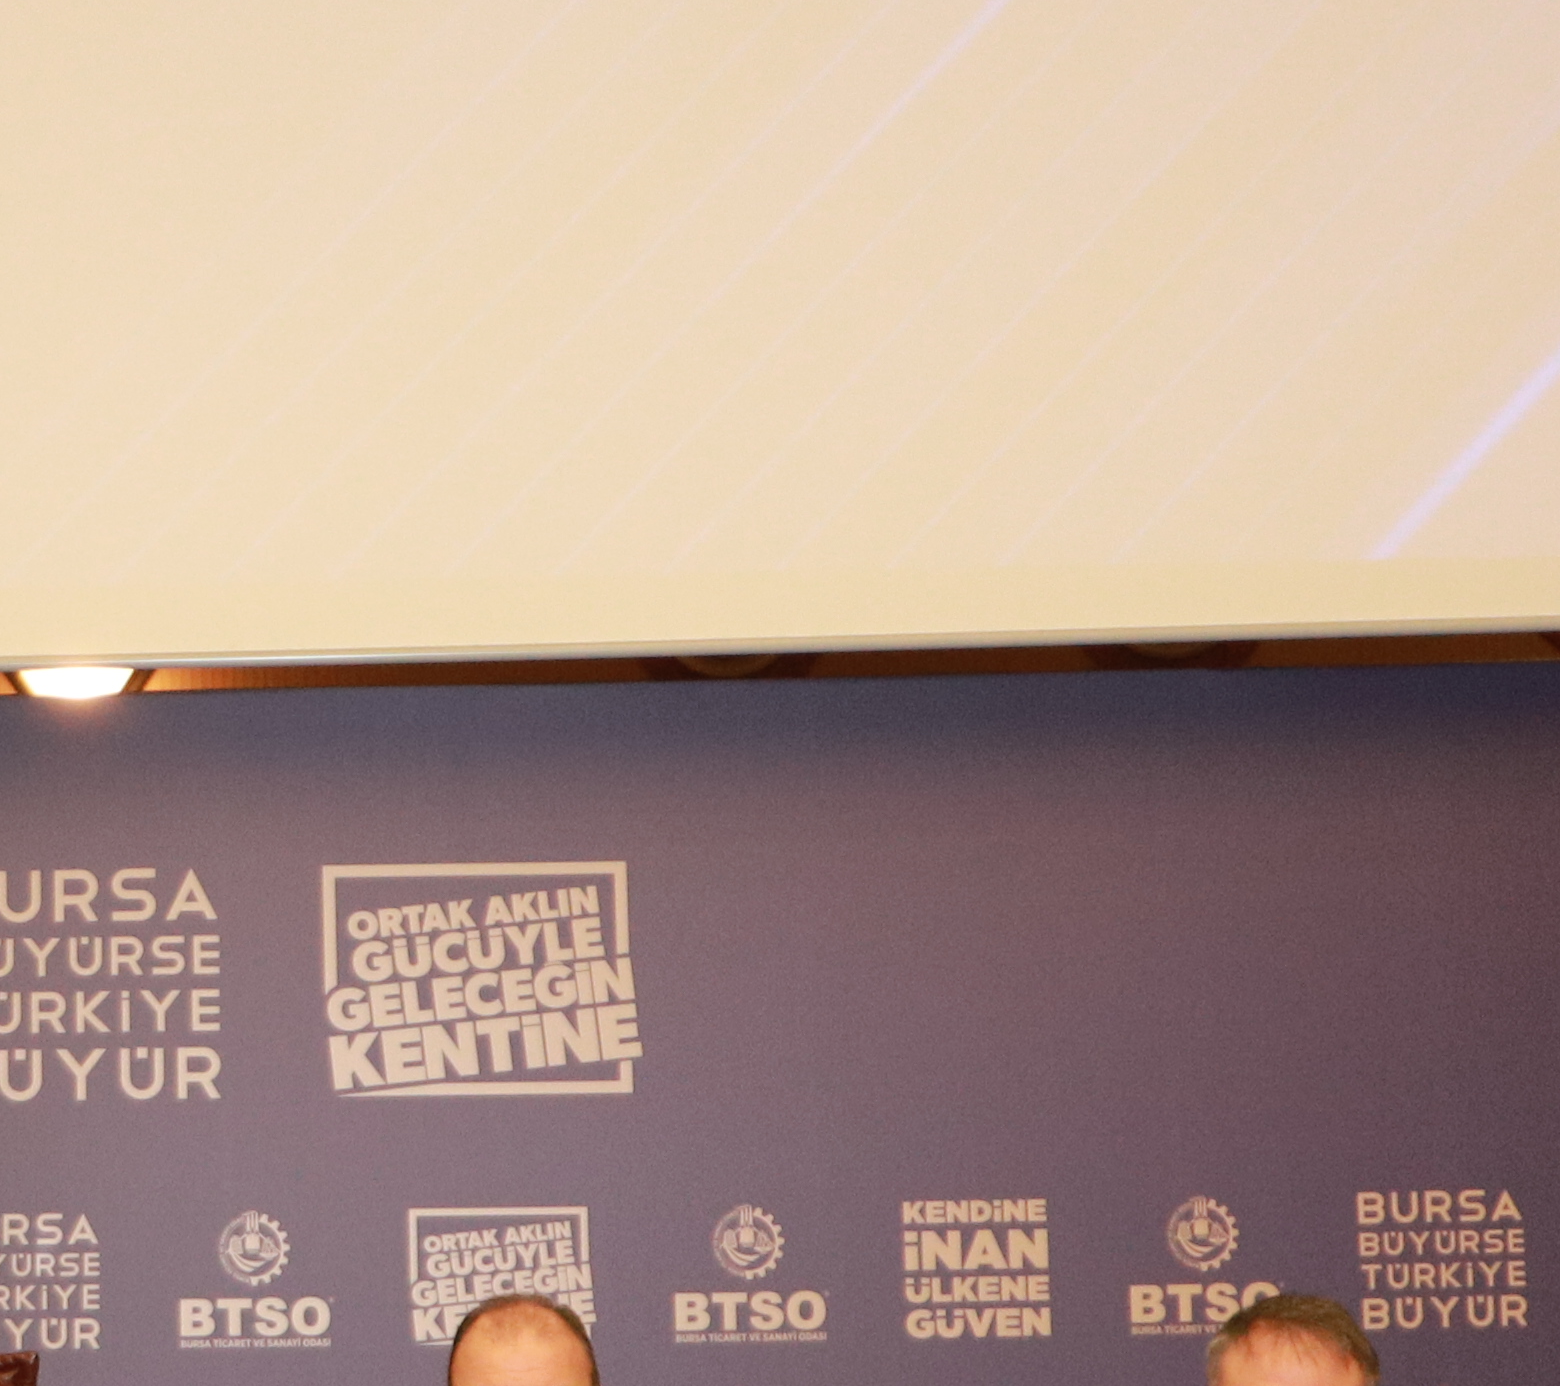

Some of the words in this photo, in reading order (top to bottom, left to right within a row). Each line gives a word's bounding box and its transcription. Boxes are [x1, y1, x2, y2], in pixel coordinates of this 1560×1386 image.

[347, 899, 477, 940] ORTAK
[485, 885, 600, 926] AKLIN
[1356, 1189, 1522, 1226] BURSA
[424, 1228, 499, 1253] ORTAK
[505, 1220, 572, 1245] AKLIN
[179, 1296, 331, 1338] BTSO
[673, 1290, 826, 1332] BTSO
[905, 1307, 1052, 1340] GÜVEN
[1361, 1294, 1527, 1331] BÜYÜR
